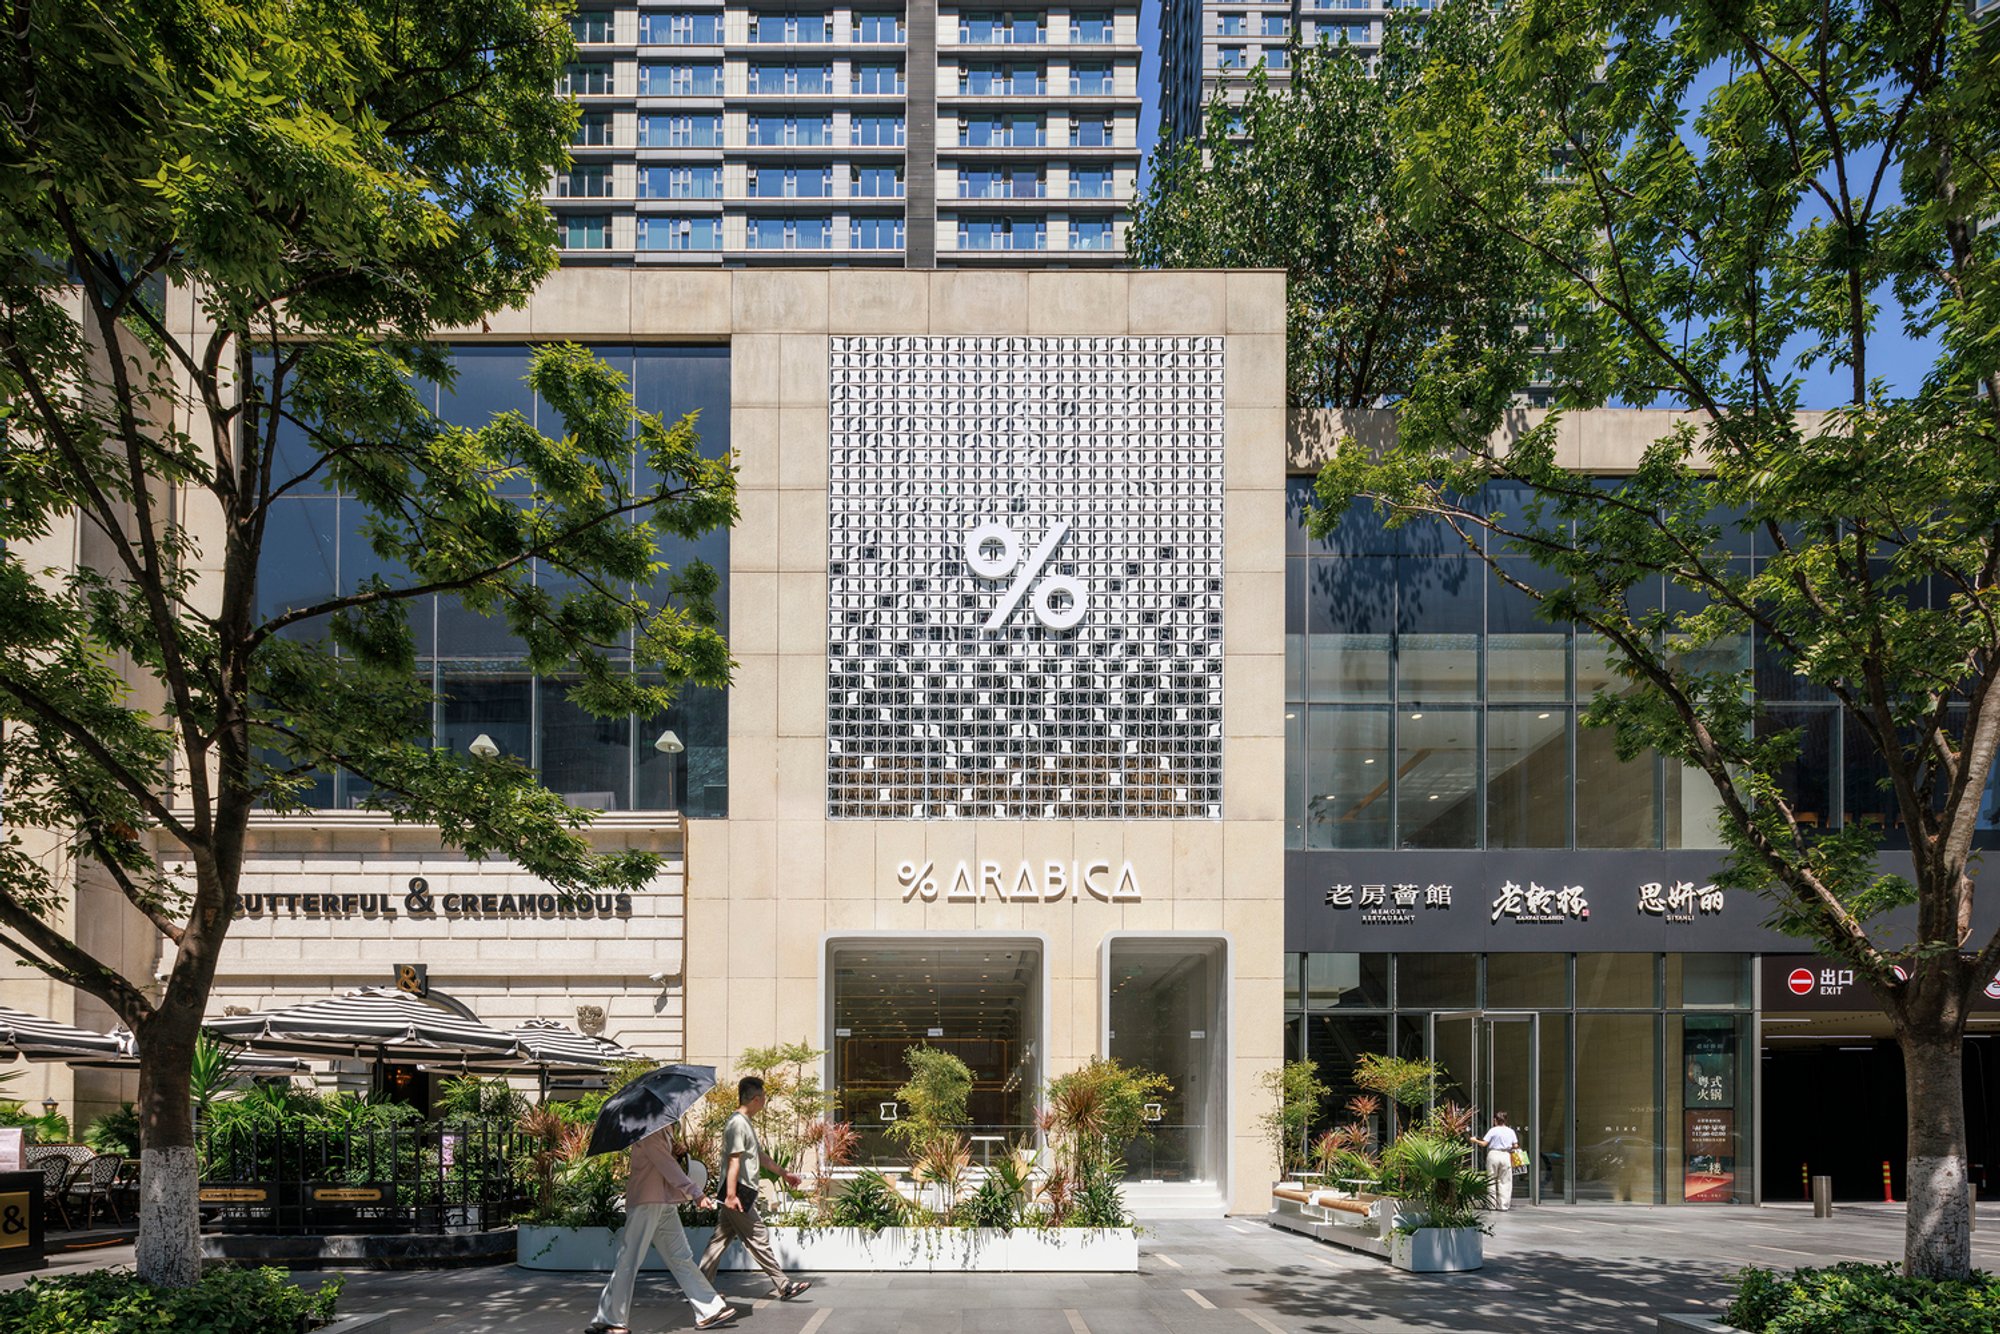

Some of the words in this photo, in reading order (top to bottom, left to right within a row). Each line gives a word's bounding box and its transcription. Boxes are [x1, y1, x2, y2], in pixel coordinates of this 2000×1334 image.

[404, 877, 435, 915] &
[442, 892, 633, 915] CREAMOROUS
[898, 860, 938, 902] %
[947, 860, 1142, 902] ARABICA
[1637, 880, 1724, 914] 思妍丽
[396, 964, 423, 994] &
[1819, 968, 1854, 986] 出口
[1819, 986, 1844, 996] EXIT
[1697, 1088, 1723, 1101] 火锅
[1698, 1075, 1723, 1089] 粤式
[2, 1204, 28, 1235] &
